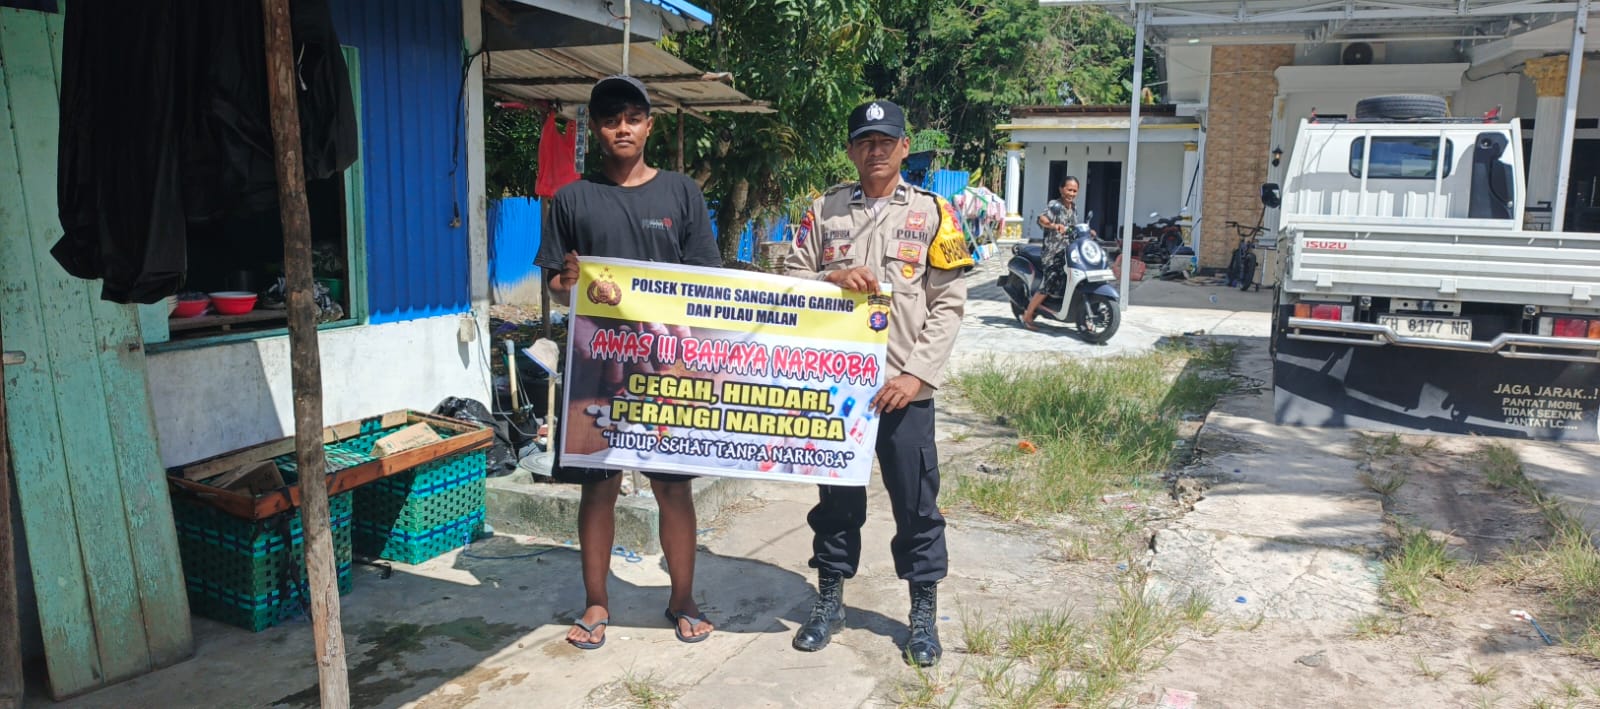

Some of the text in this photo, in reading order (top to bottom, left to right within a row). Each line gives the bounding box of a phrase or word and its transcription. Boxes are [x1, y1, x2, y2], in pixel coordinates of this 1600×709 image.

[897, 229, 928, 241] POLRI
[1305, 241, 1347, 249] ISUZU
[632, 278, 677, 295] POLSEK
[680, 283, 731, 301] TEWANG
[734, 288, 805, 308] SANGALANG
[808, 296, 854, 312] GARING
[686, 303, 797, 326] DAN PULAU MALAN
[1381, 317, 1469, 335] KH 8177 NR
[591, 329, 654, 363] AWAS
[682, 338, 768, 377] BAHAYA
[773, 347, 878, 386] NARKOBA
[628, 374, 833, 413] CEGAH, HINDARI,
[1493, 384, 1531, 395] JAGA
[1502, 398, 1582, 410] PANTAT MOBIL
[1502, 407, 1582, 420] TIDAK SEENAK
[611, 400, 844, 440] PERANGI NARKOBA
[660, 438, 712, 456] SEHAT
[715, 442, 769, 461] TANPA
